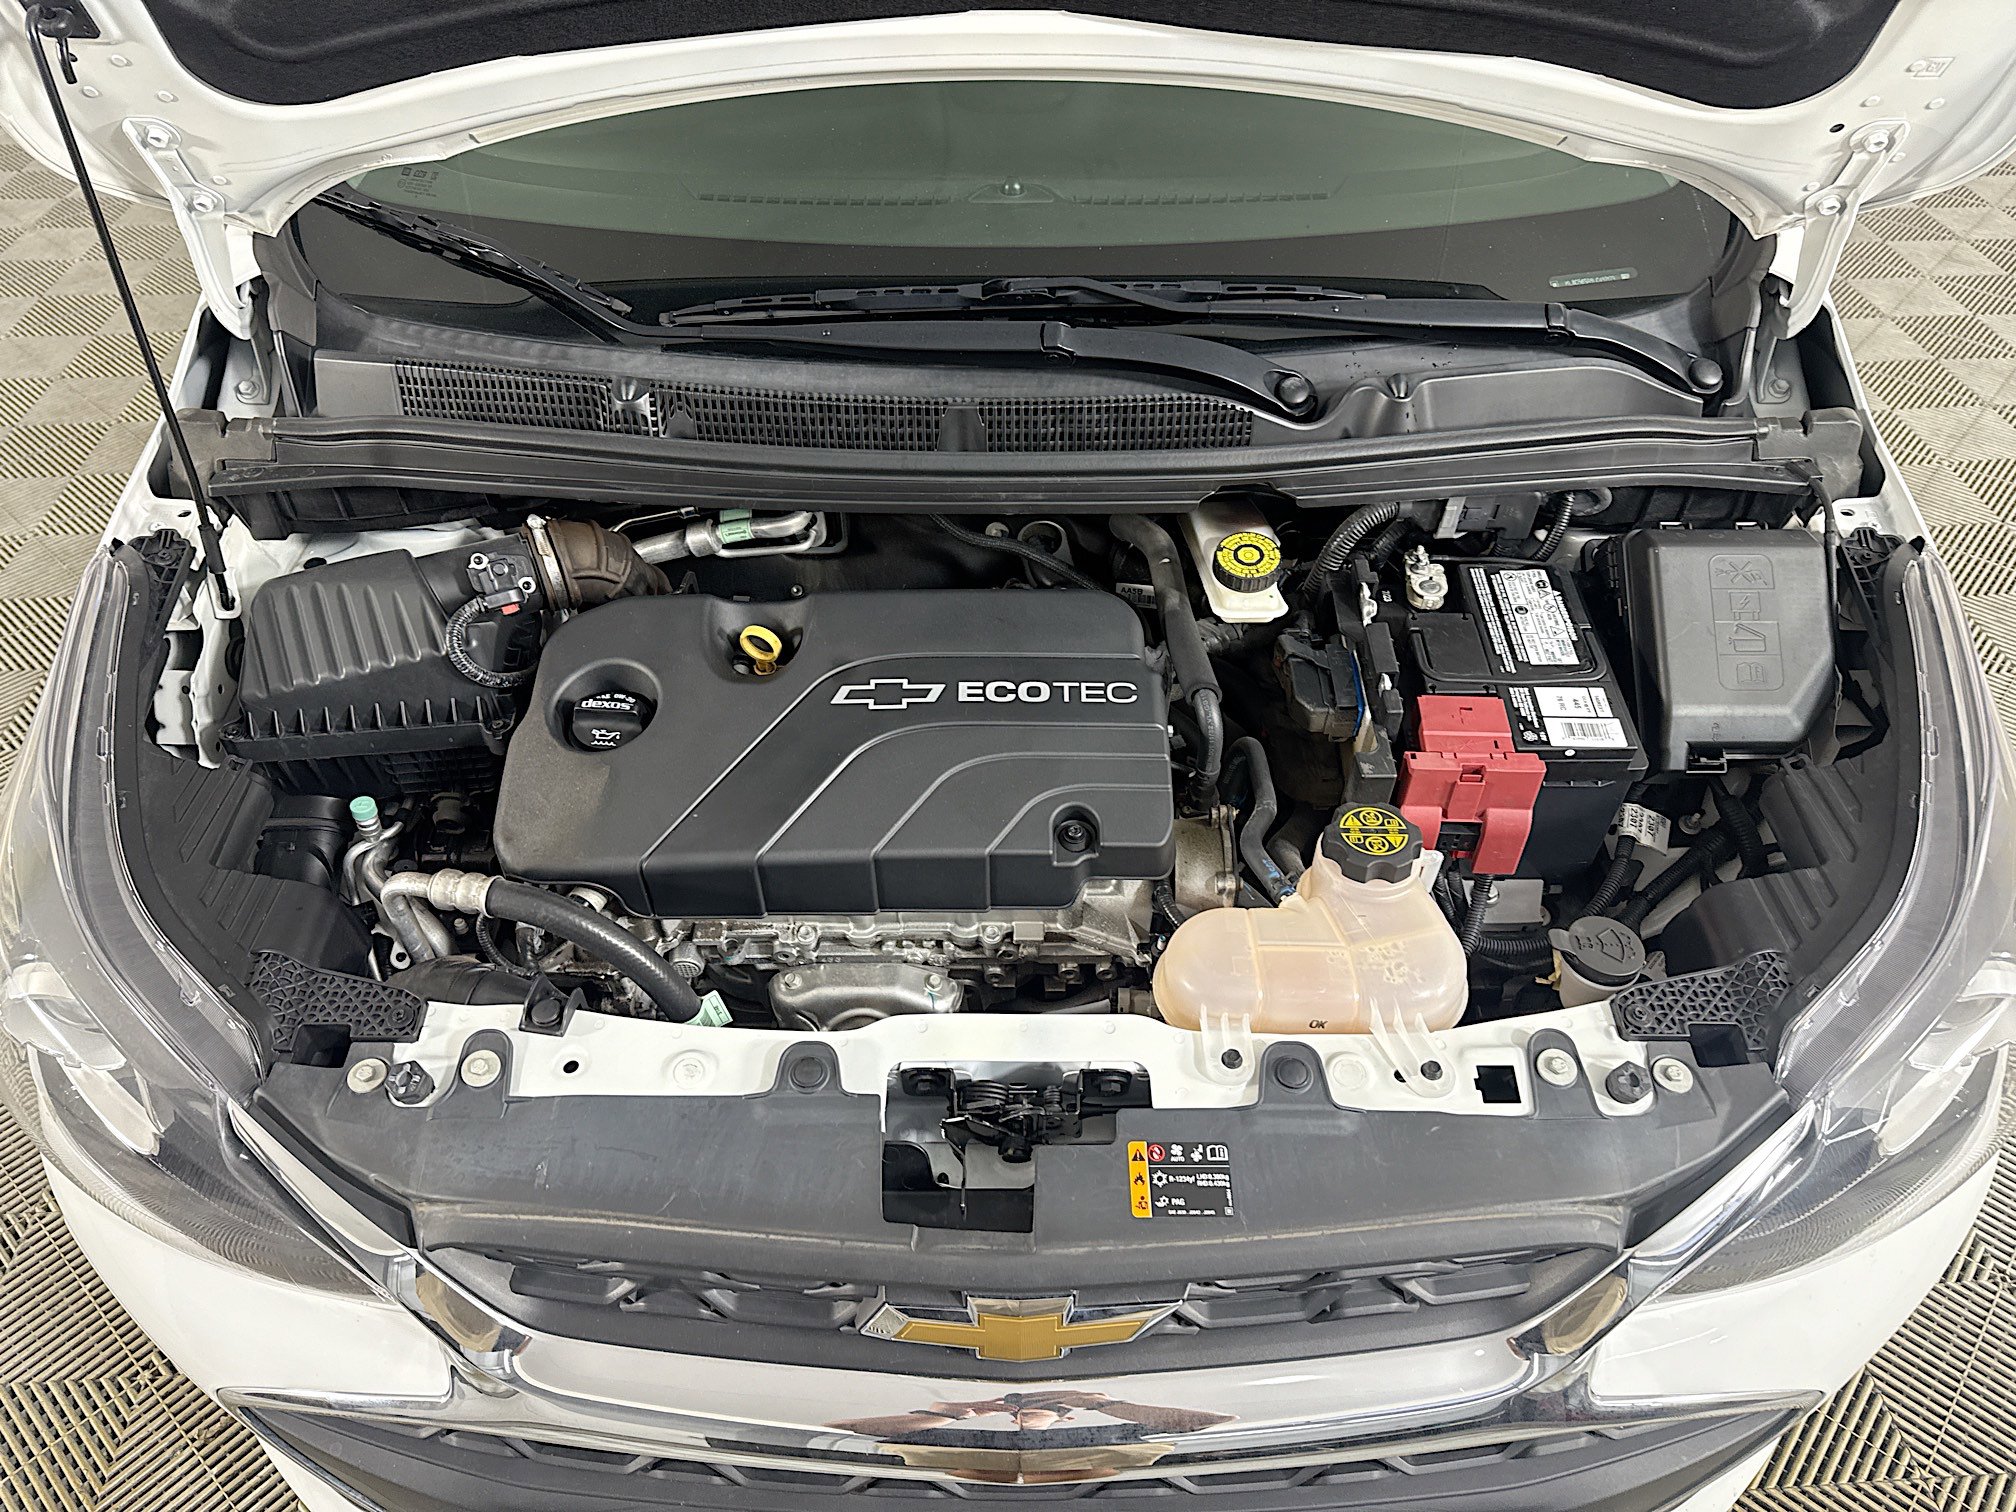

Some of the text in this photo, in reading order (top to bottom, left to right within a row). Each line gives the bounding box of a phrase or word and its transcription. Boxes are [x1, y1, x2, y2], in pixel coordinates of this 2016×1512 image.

[957, 680, 1139, 704] ECOTEC
[581, 698, 634, 711] dexos
[1170, 1197, 1186, 1206] PAG
